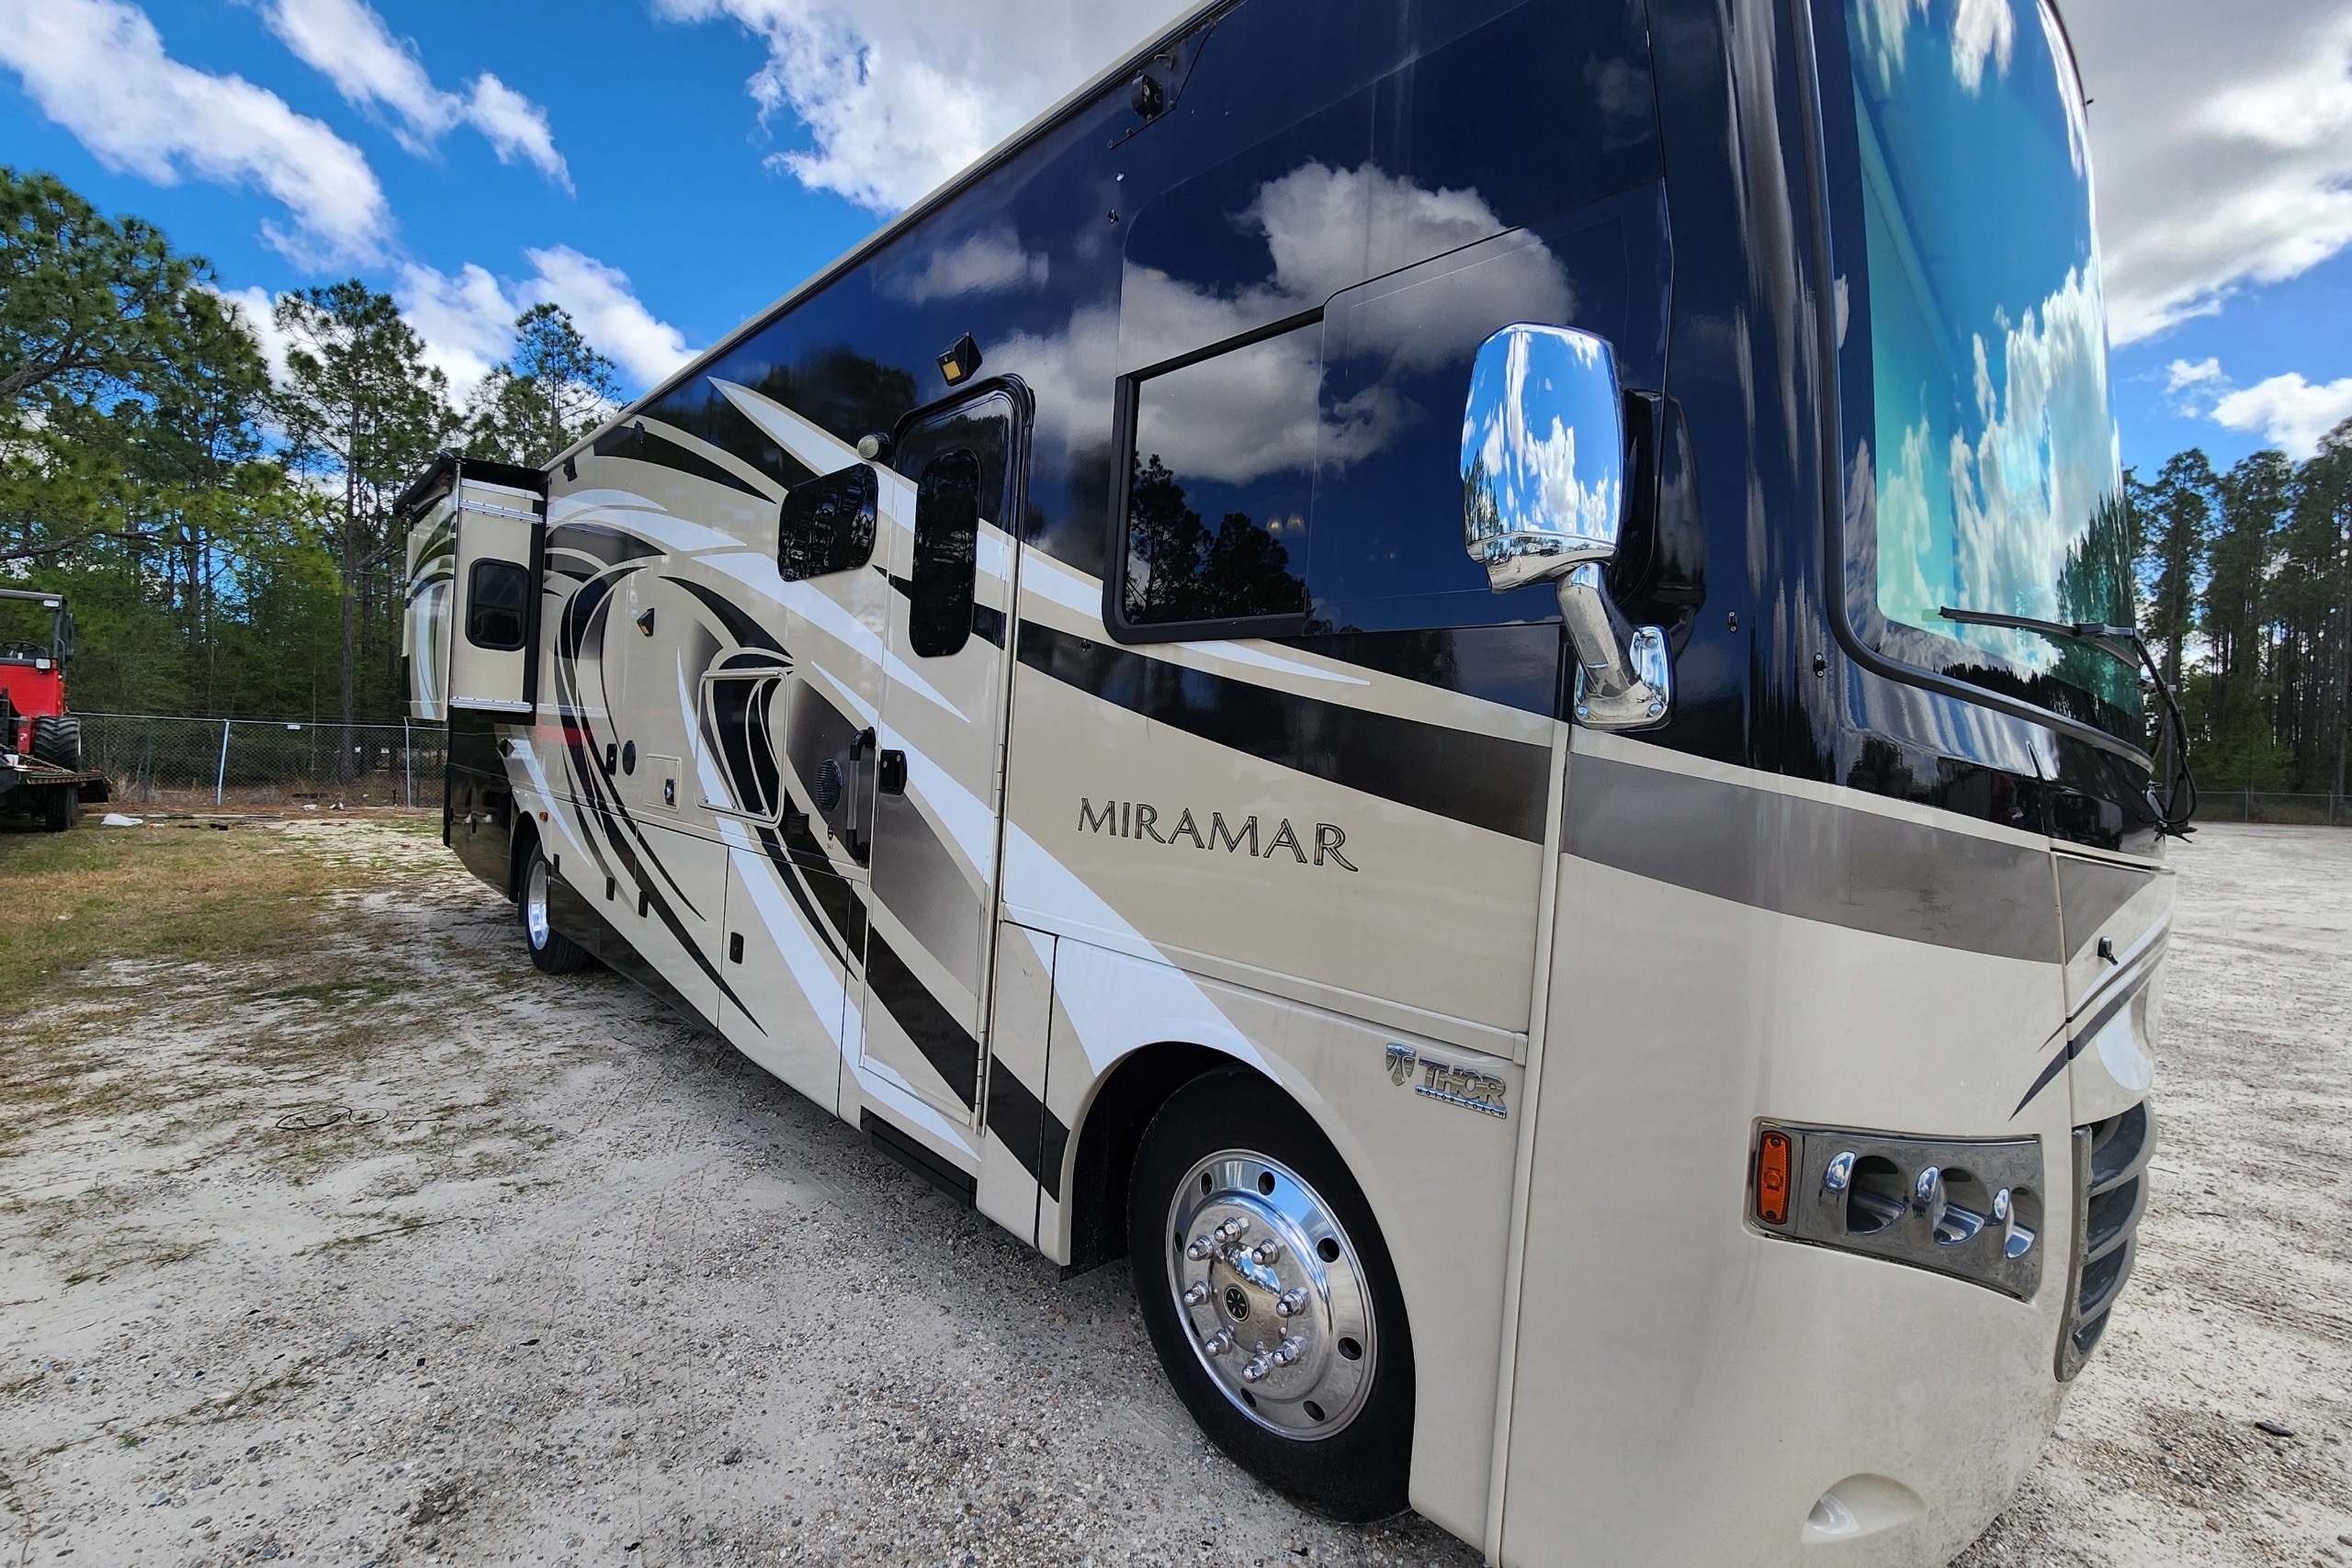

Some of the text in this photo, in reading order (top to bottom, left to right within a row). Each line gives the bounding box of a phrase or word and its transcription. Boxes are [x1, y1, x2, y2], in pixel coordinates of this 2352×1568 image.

[1077, 797, 1360, 873] MIRAMAR
[1417, 1088, 1505, 1117] MOTOR COACH
[1419, 1056, 1506, 1109] THOR
